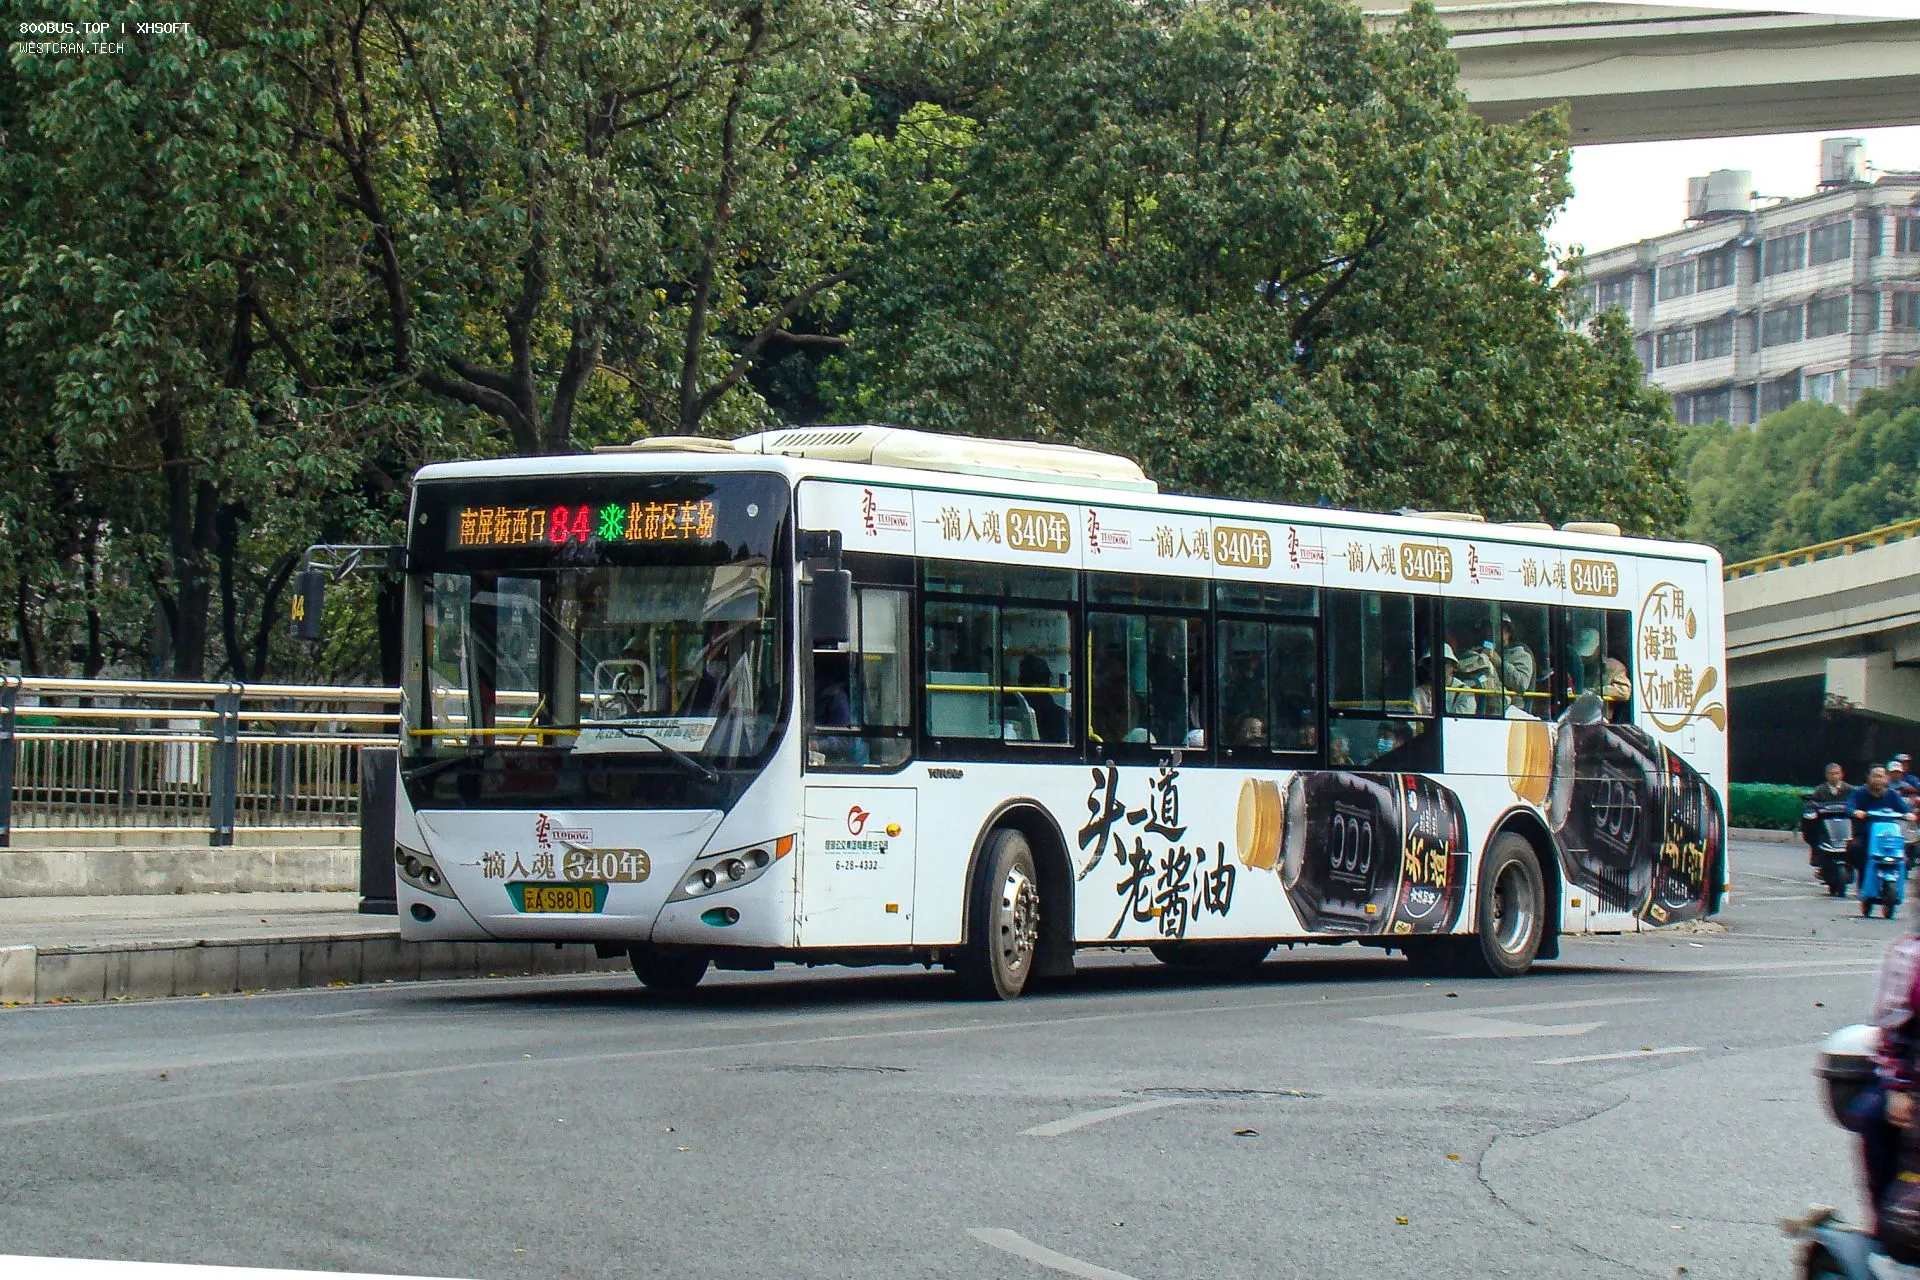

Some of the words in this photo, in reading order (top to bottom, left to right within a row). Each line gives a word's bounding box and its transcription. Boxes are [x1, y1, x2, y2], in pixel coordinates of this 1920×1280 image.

[459, 506, 546, 545] 南屏街西口
[550, 504, 591, 544] 84
[624, 500, 714, 541] 北市区车场
[1009, 511, 1069, 551] 340年
[1216, 530, 1269, 566] 340年
[1402, 545, 1452, 583] 340年
[1572, 562, 1618, 594] 340年
[1652, 588, 1685, 625] 不用
[1643, 625, 1679, 662] 海盐
[1643, 663, 1694, 709] 不加糖
[569, 851, 646, 882] 340年
[835, 860, 878, 871] 6-28-4332
